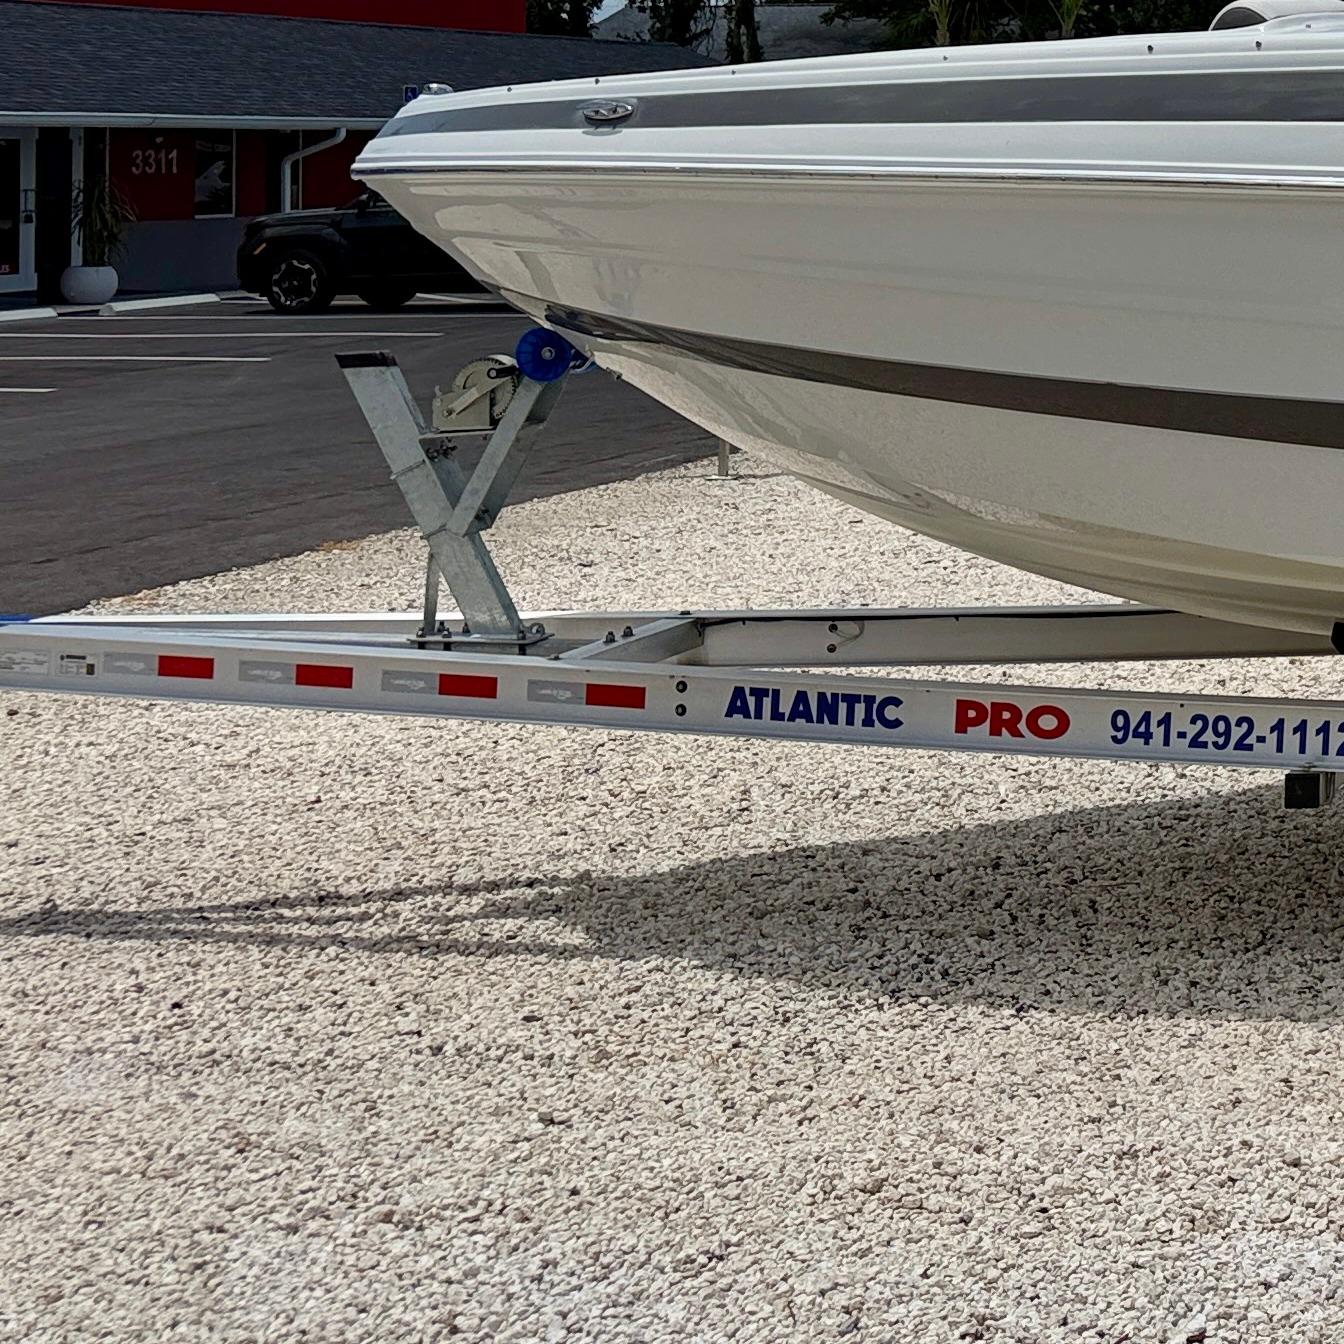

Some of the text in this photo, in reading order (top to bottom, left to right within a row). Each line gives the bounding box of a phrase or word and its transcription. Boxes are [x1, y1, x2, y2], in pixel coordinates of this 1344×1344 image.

[131, 148, 178, 175] 3311
[725, 686, 903, 729] ATLANTIC
[956, 699, 1069, 739] PRO
